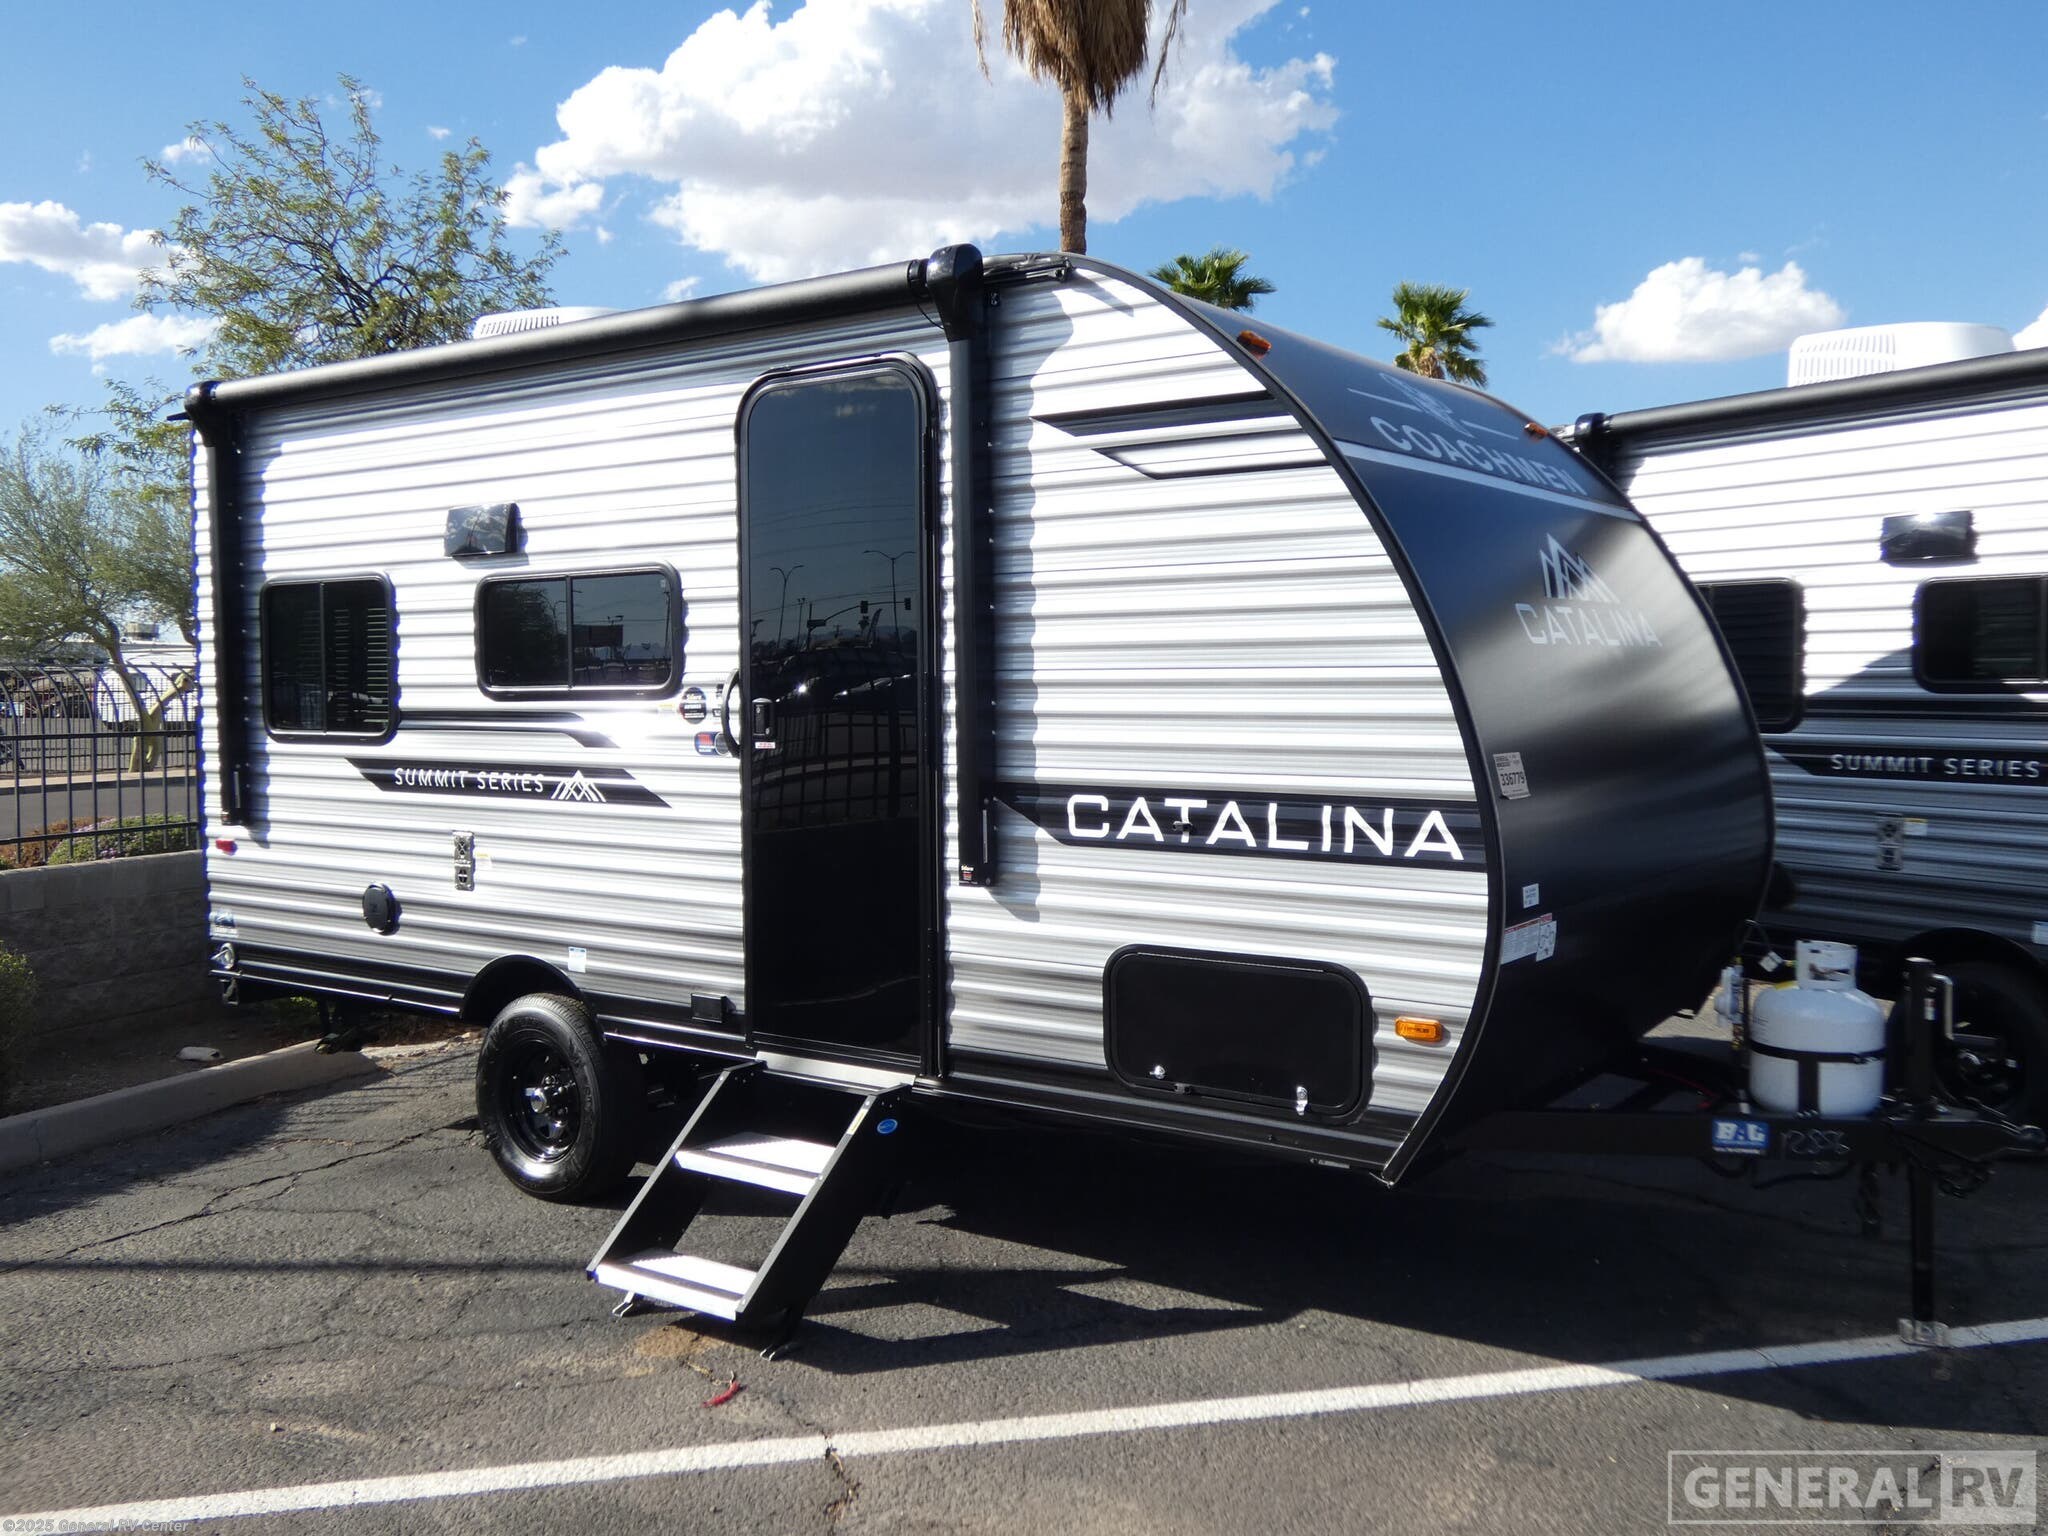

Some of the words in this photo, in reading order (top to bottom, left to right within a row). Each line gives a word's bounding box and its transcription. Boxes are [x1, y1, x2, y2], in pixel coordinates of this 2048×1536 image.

[1370, 416, 1588, 496] COACHMEN
[1514, 602, 1663, 648] CATALINA
[394, 768, 469, 789] SUMMIT
[477, 770, 545, 792] SERIES
[1830, 754, 1934, 774] SUMMIT
[1943, 757, 2041, 778] SERIES
[1066, 794, 1465, 861] CATALINA
